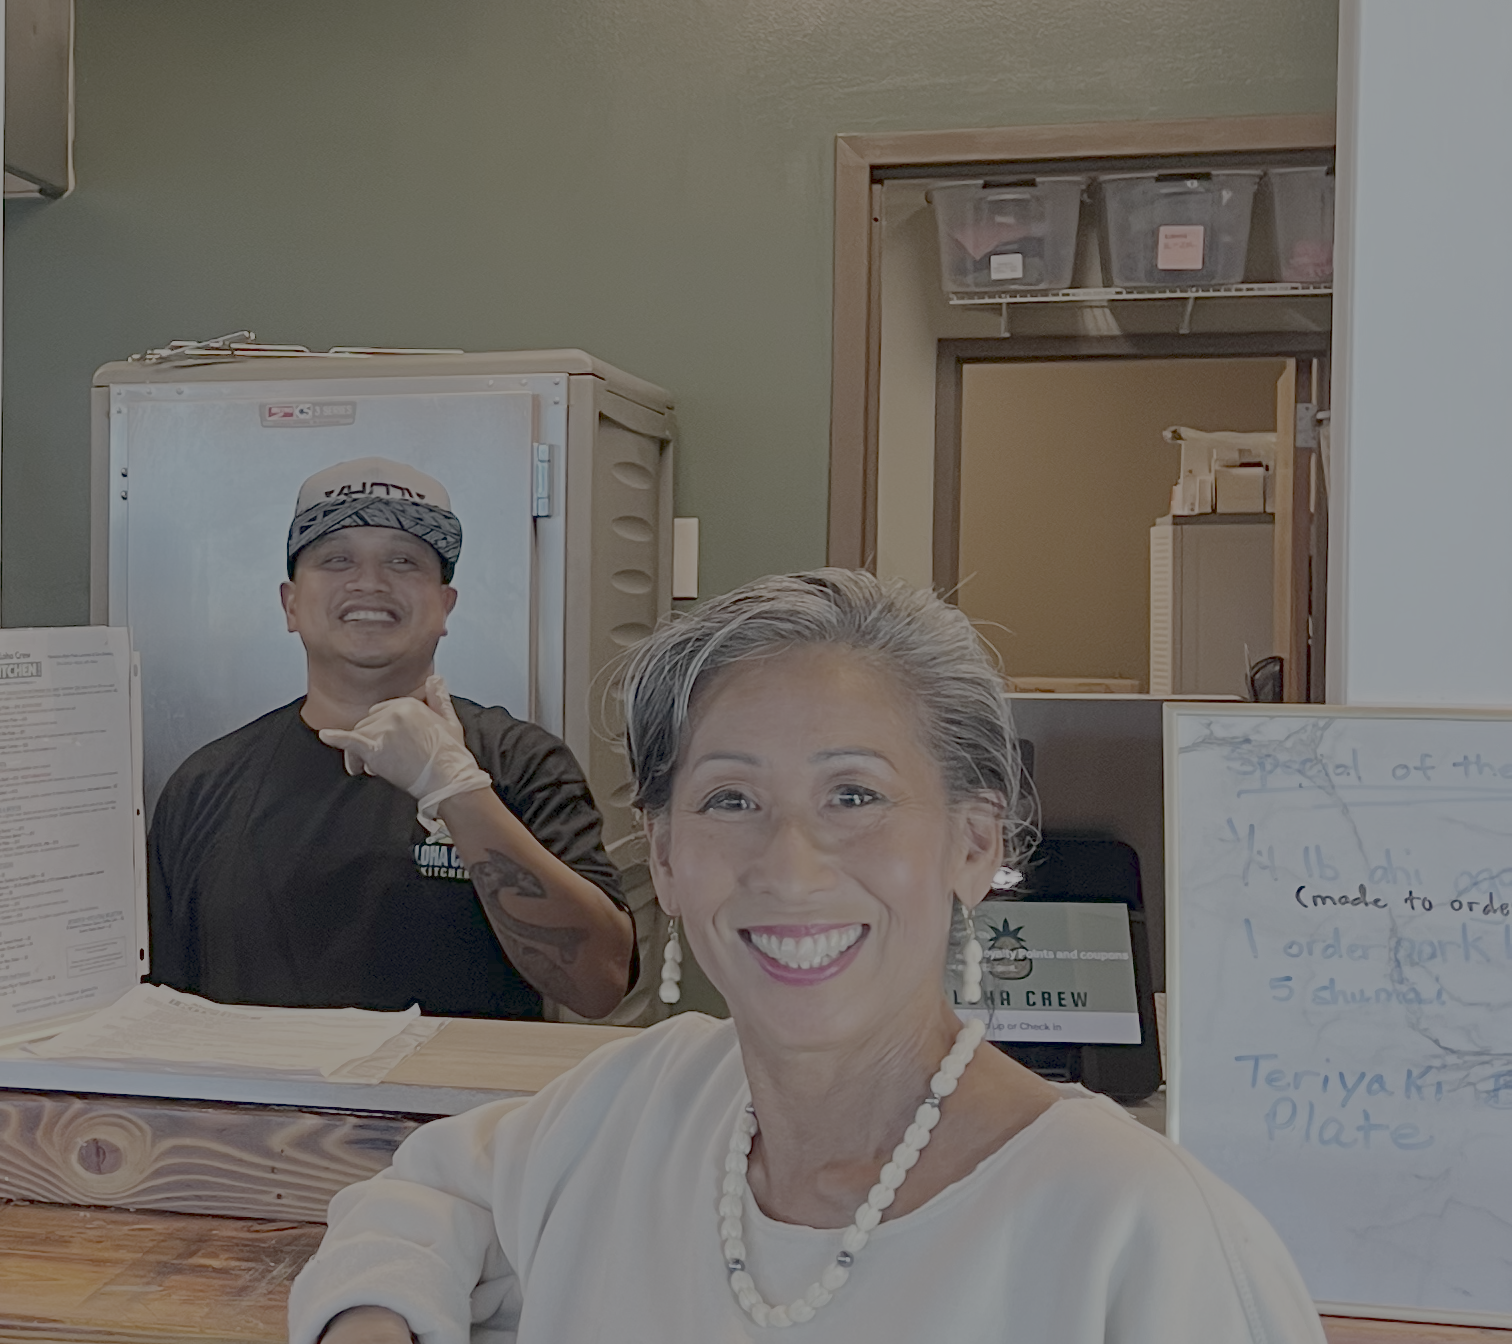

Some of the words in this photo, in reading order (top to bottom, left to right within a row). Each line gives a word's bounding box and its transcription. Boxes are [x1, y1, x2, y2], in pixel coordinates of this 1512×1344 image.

[1224, 747, 1362, 789] Special
[1392, 753, 1436, 782] of
[413, 844, 449, 867] LOHA
[1404, 888, 1433, 912] to
[983, 949, 1018, 960] oyalty
[1019, 949, 1055, 960] Points
[1056, 949, 1078, 960] and
[1079, 950, 1129, 961] coupons
[1282, 926, 1371, 961] order
[953, 990, 1011, 1006] LHA
[1025, 990, 1088, 1007] CREW
[1268, 975, 1293, 1002] 5
[1007, 1023, 1018, 1031] or
[1019, 1021, 1051, 1032] Check
[1052, 1022, 1063, 1031] in
[1263, 1095, 1436, 1151] Plate
